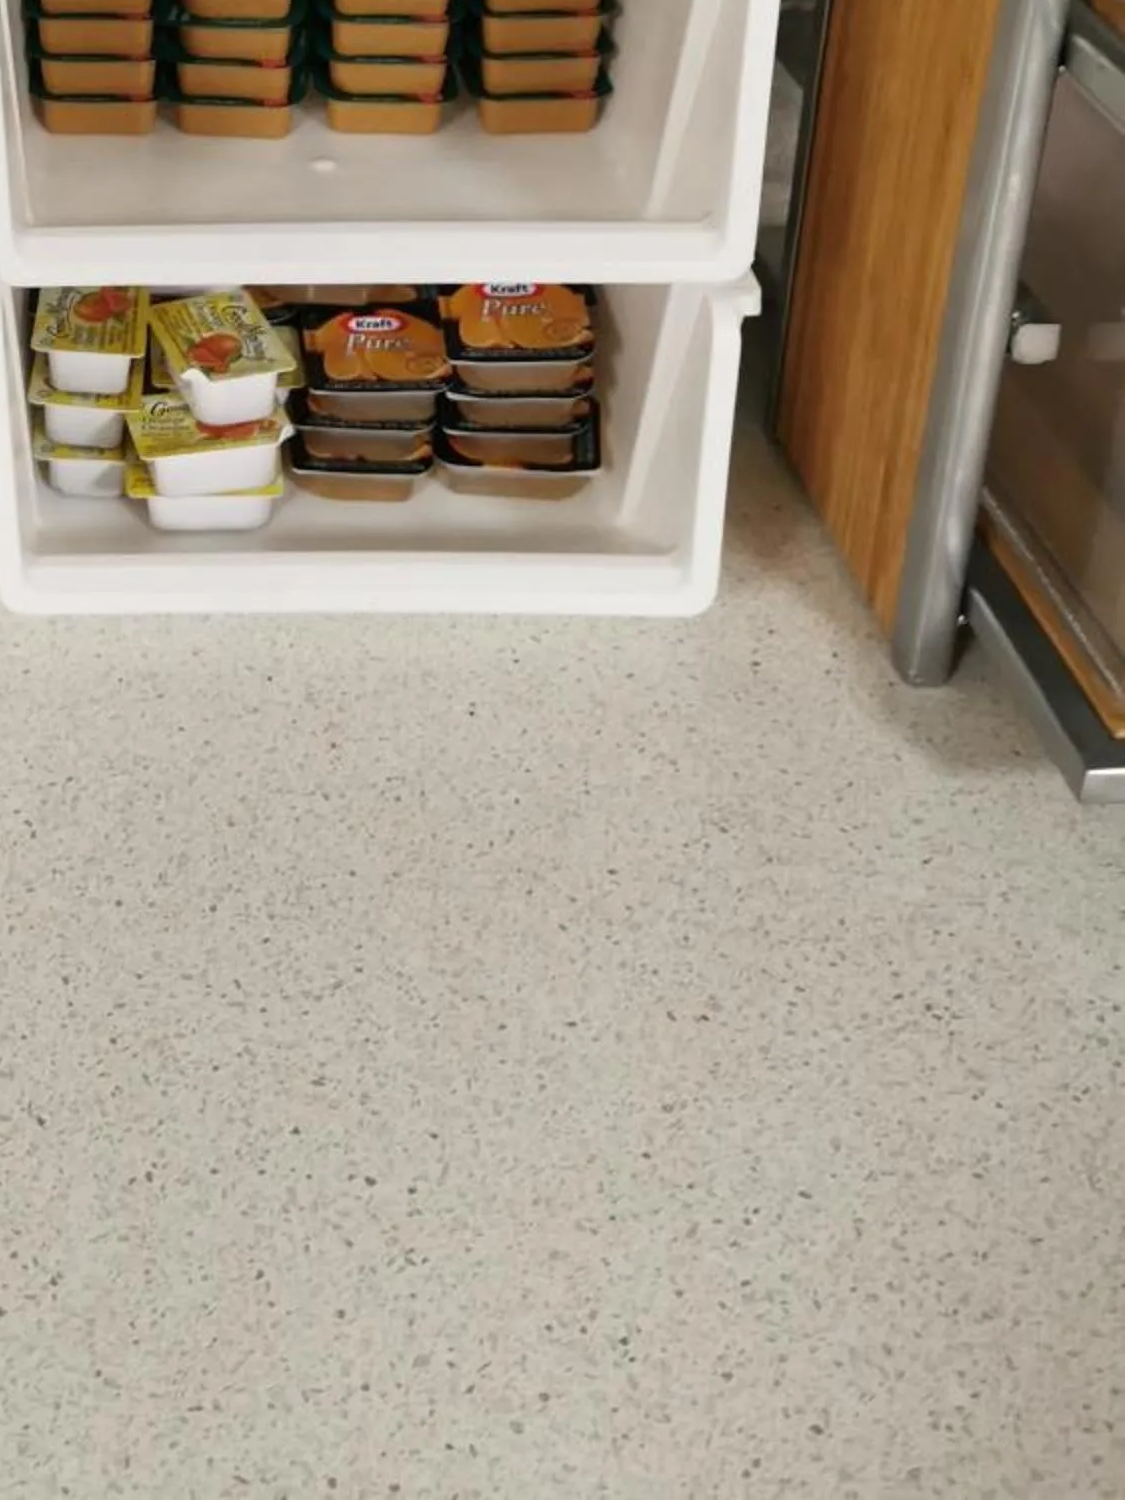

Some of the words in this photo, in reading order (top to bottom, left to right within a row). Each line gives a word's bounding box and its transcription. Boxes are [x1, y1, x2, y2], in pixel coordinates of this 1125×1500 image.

[489, 283, 528, 294] Kraft
[482, 299, 546, 320] Pure
[355, 317, 394, 329] Kraft
[347, 333, 411, 355] Pure
